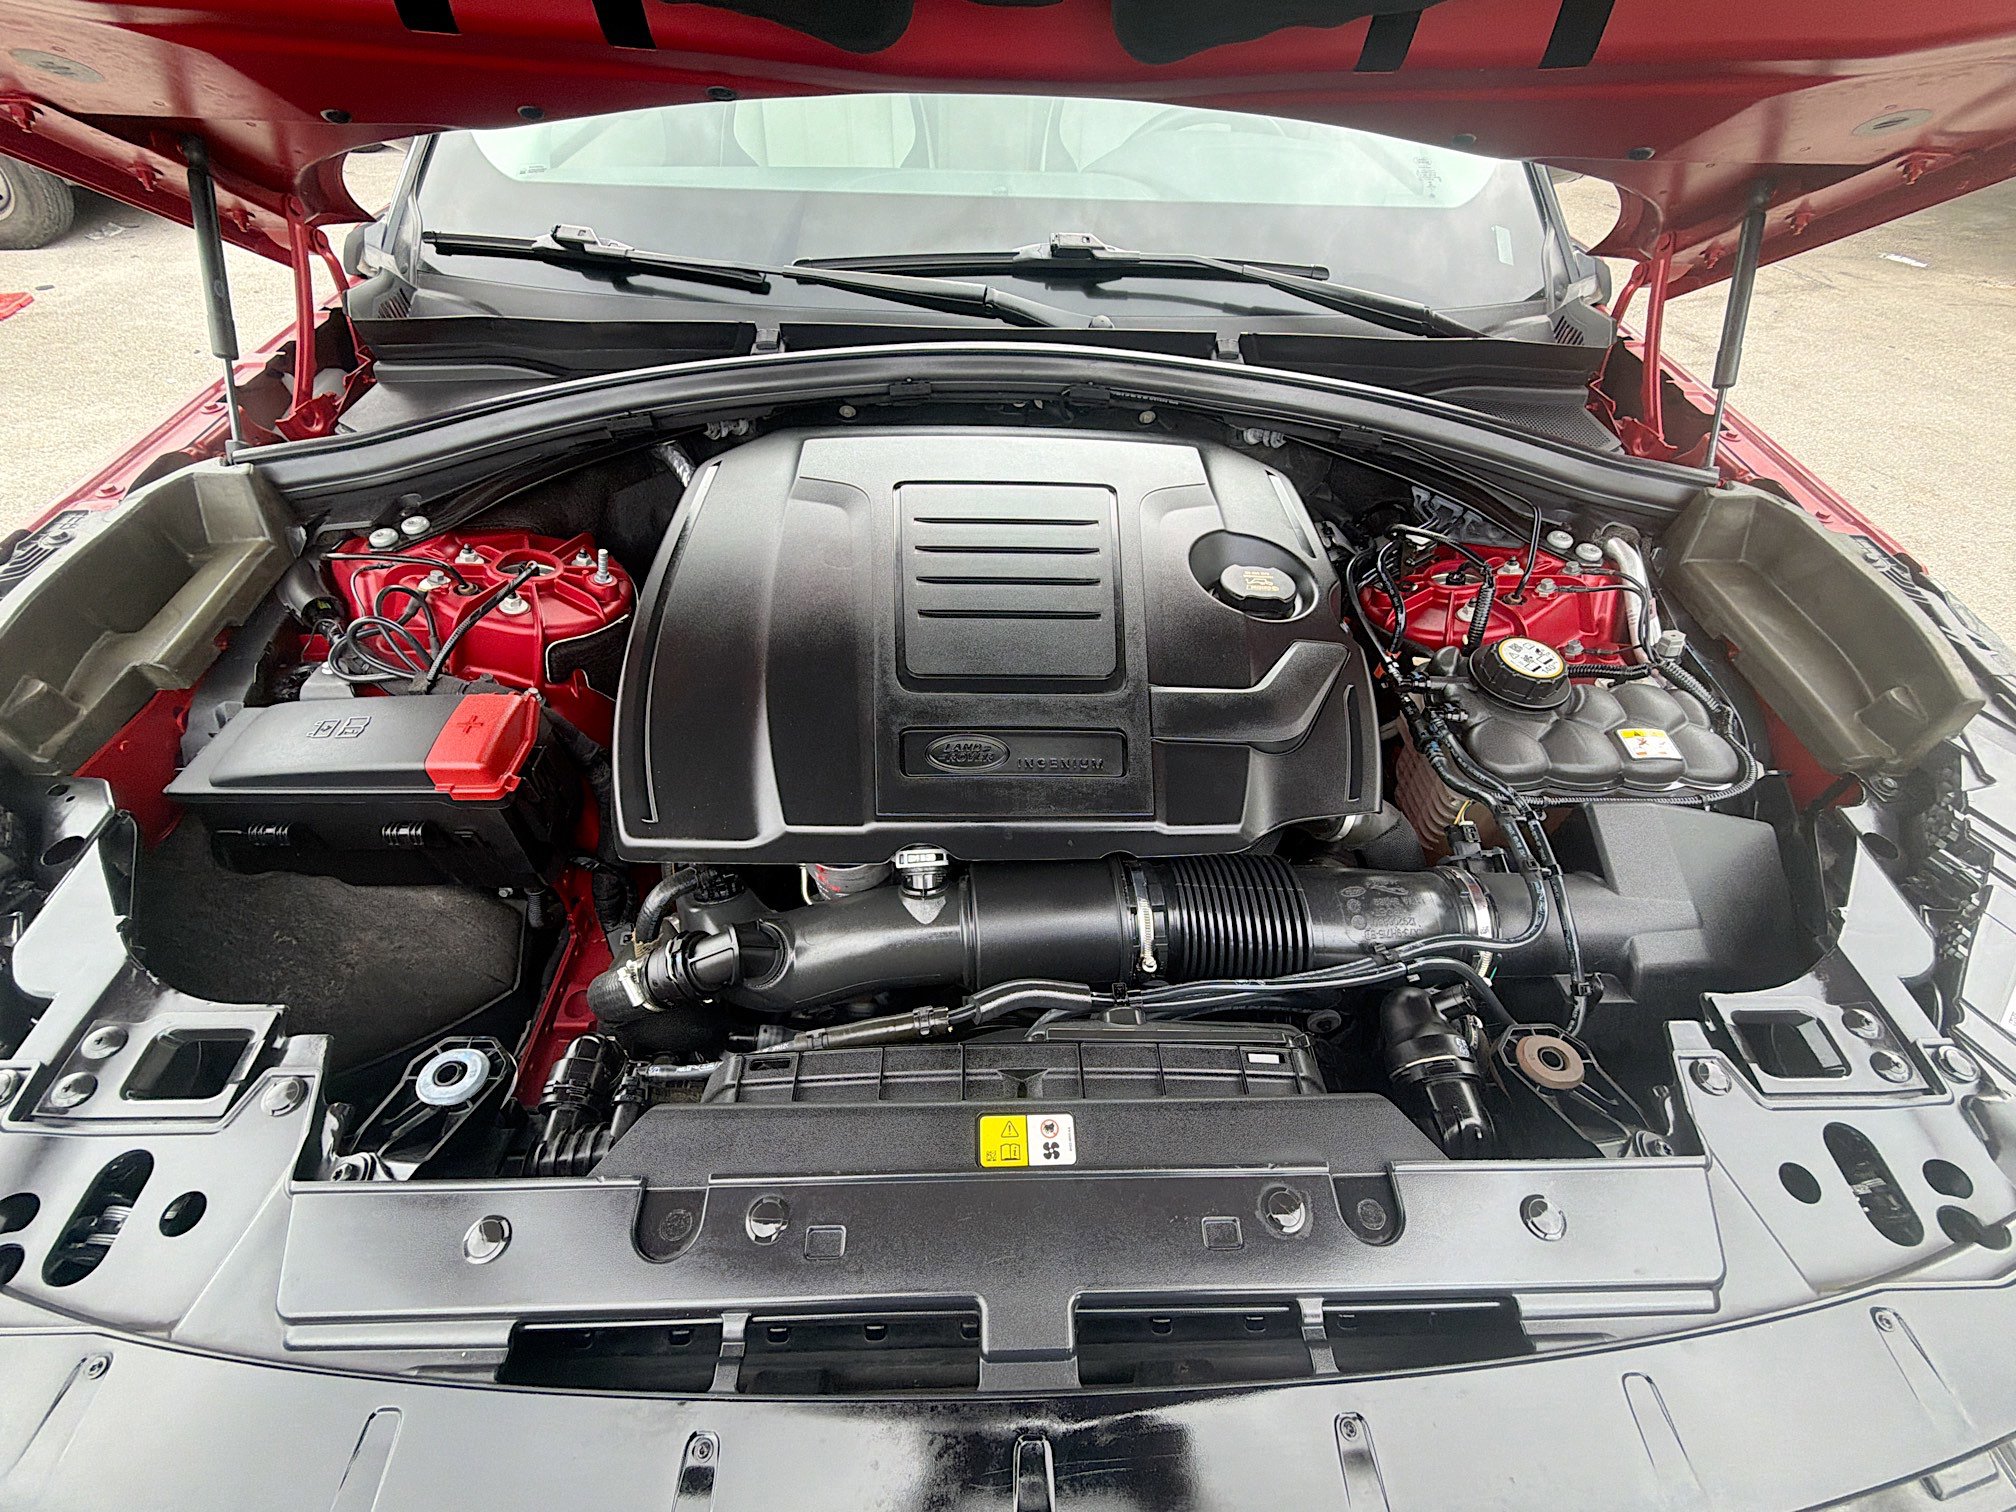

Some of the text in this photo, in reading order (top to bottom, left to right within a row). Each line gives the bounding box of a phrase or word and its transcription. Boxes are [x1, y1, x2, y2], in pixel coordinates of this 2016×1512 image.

[944, 743, 983, 752] LAND
[945, 751, 994, 763] ROVER
[1017, 757, 1105, 769] INGENIUM
